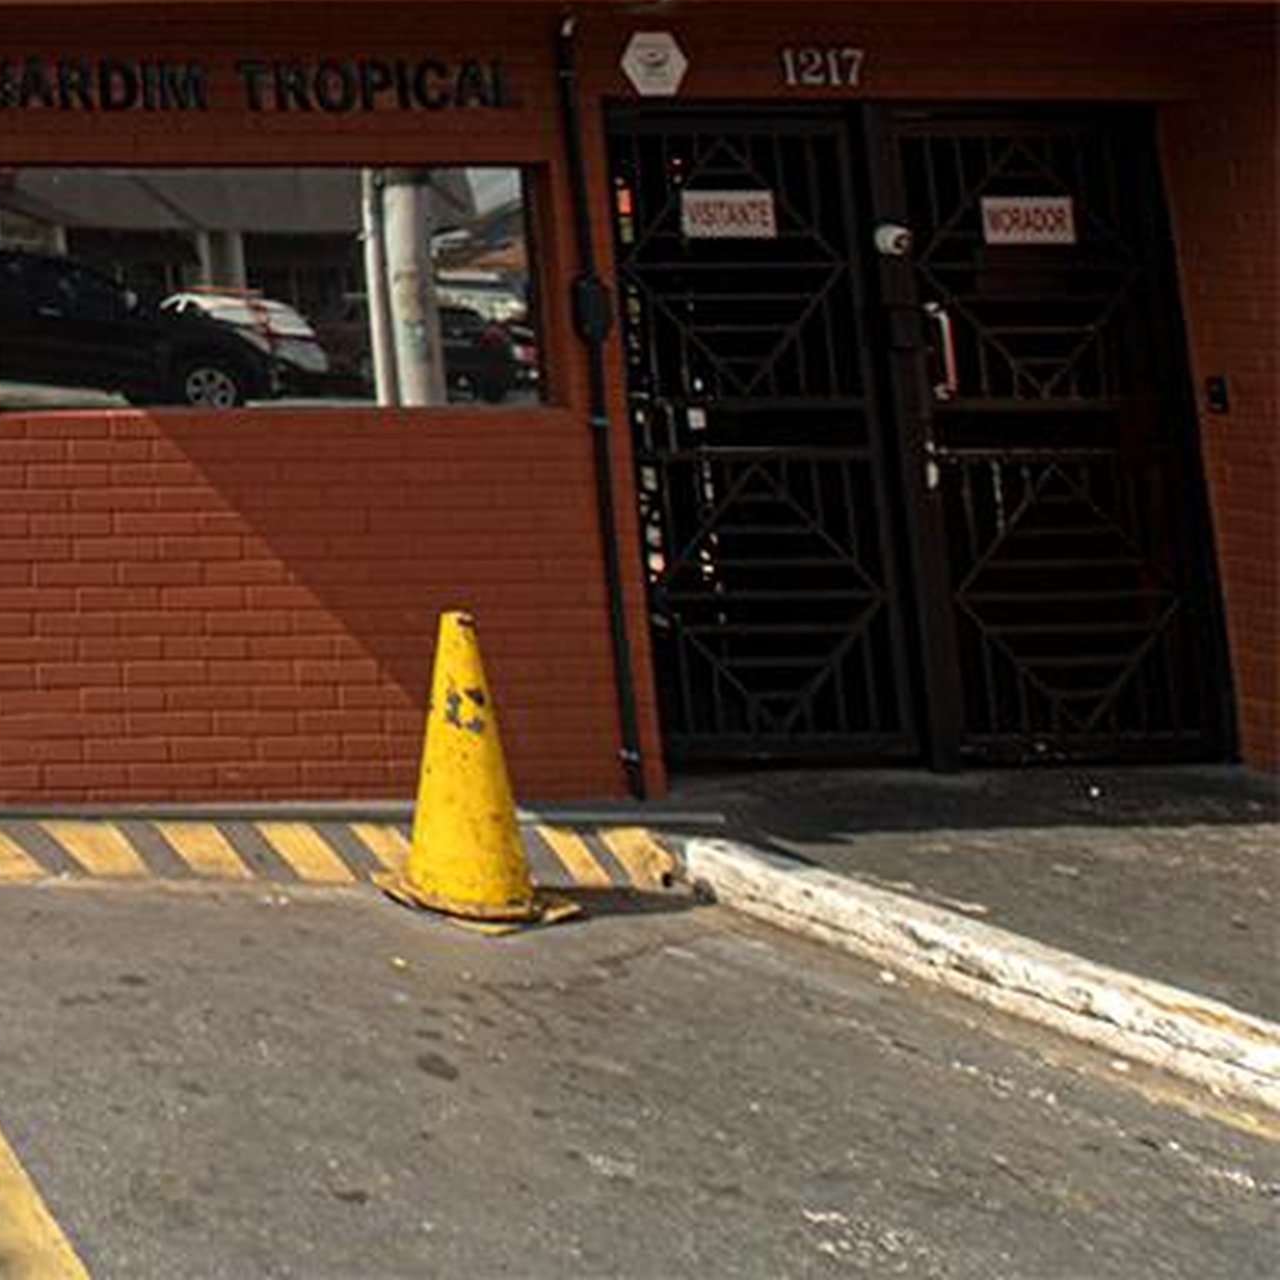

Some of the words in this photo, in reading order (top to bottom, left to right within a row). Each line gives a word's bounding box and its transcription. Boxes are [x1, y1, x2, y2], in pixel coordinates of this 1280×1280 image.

[783, 47, 864, 86] 1217
[235, 56, 523, 113] TROPICAL
[688, 199, 771, 227] VISITANTE
[988, 206, 1068, 234] MORADOR
